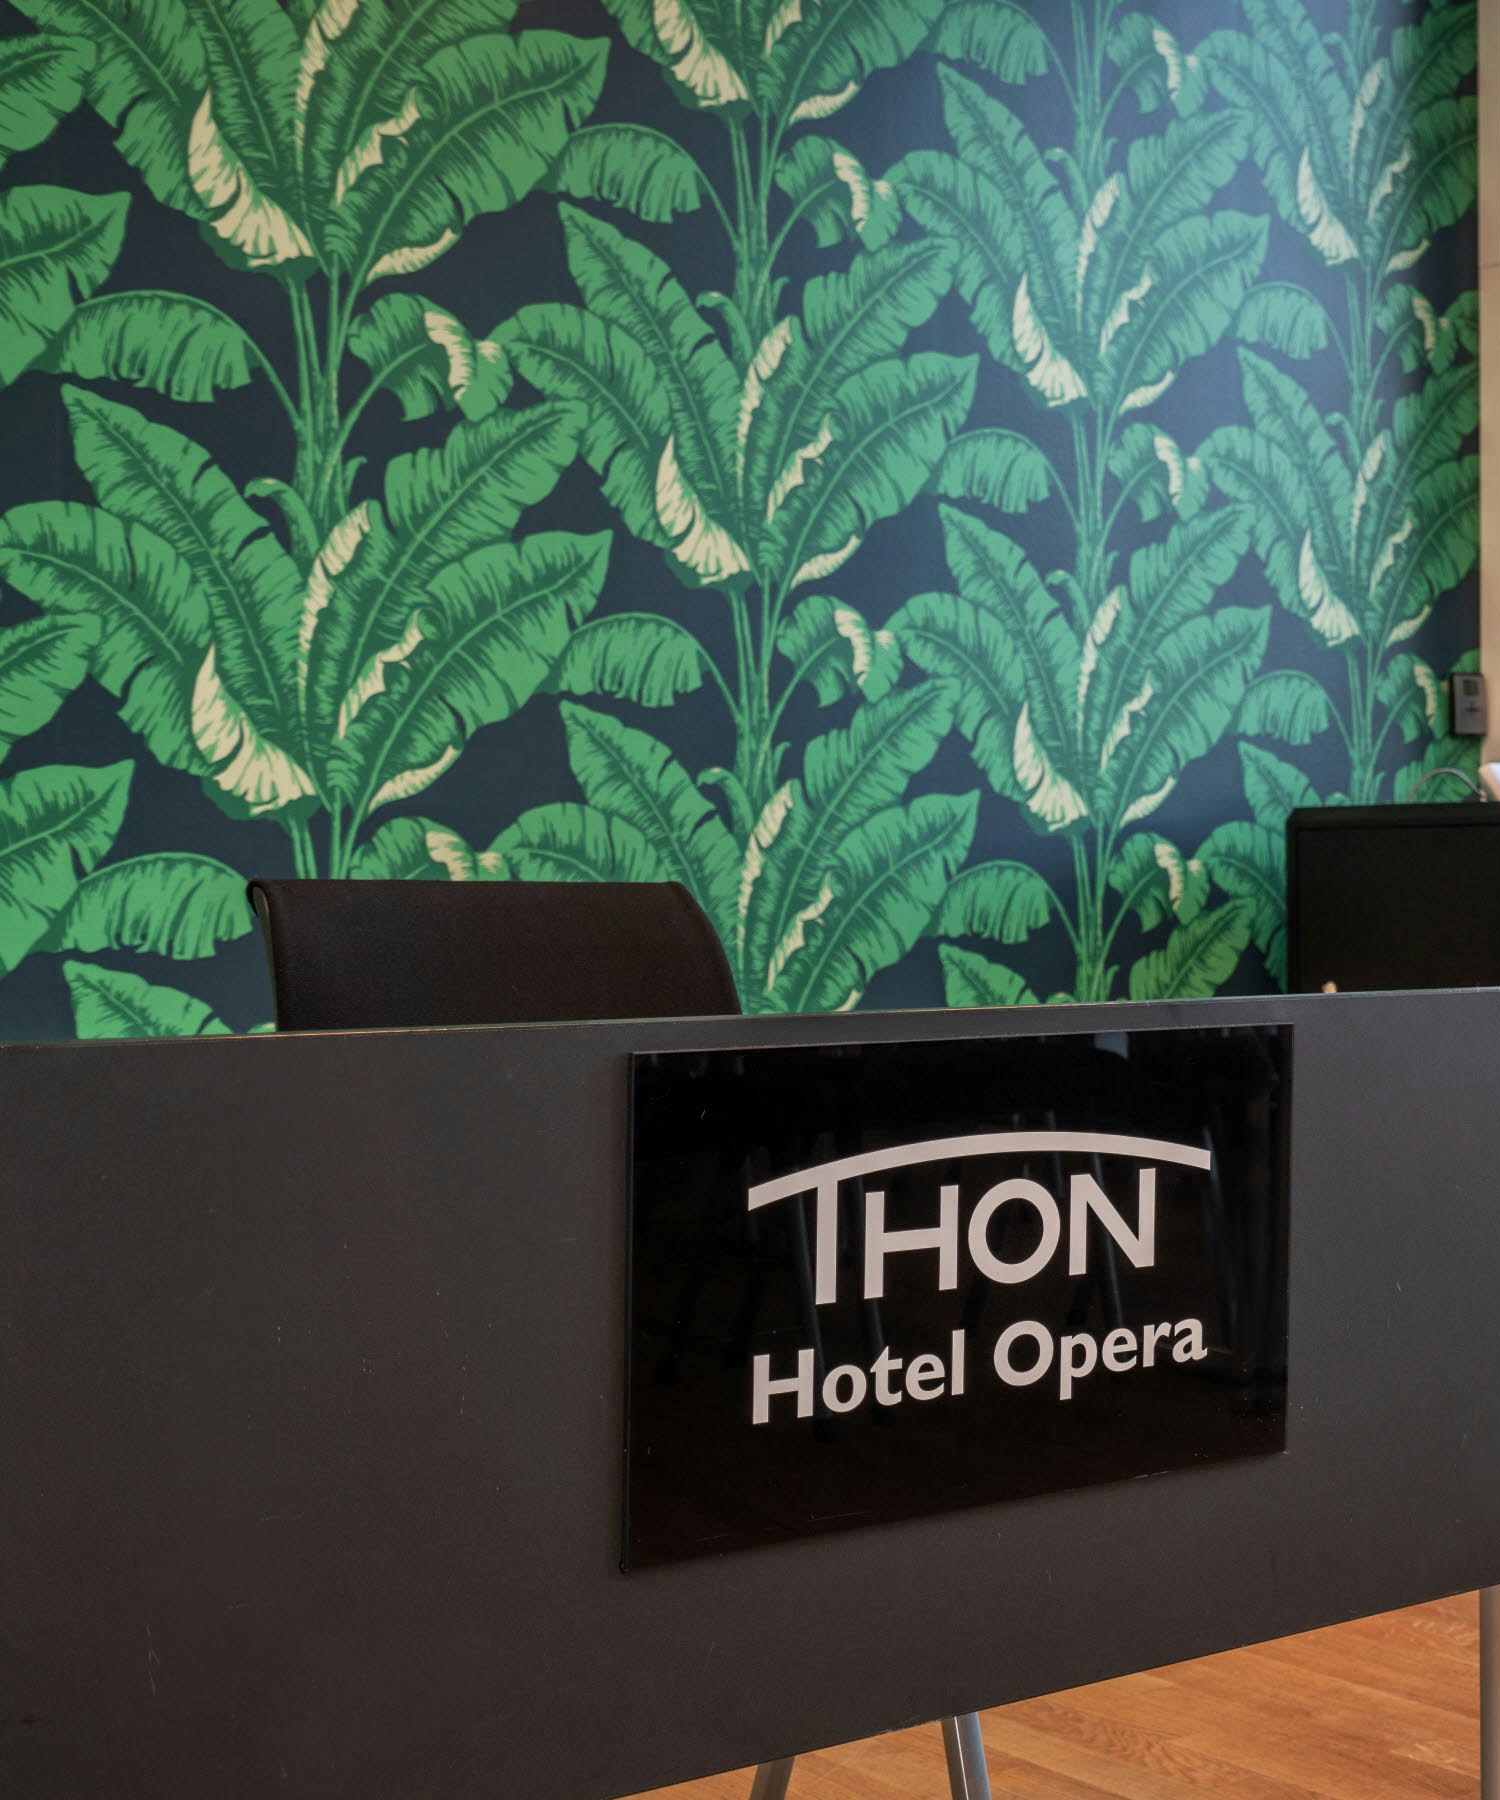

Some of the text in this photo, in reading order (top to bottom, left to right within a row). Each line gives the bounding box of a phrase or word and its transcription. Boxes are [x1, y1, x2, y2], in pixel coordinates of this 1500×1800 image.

[748, 1132, 1210, 1304] THON
[753, 1319, 1207, 1424] Hotel Opera
